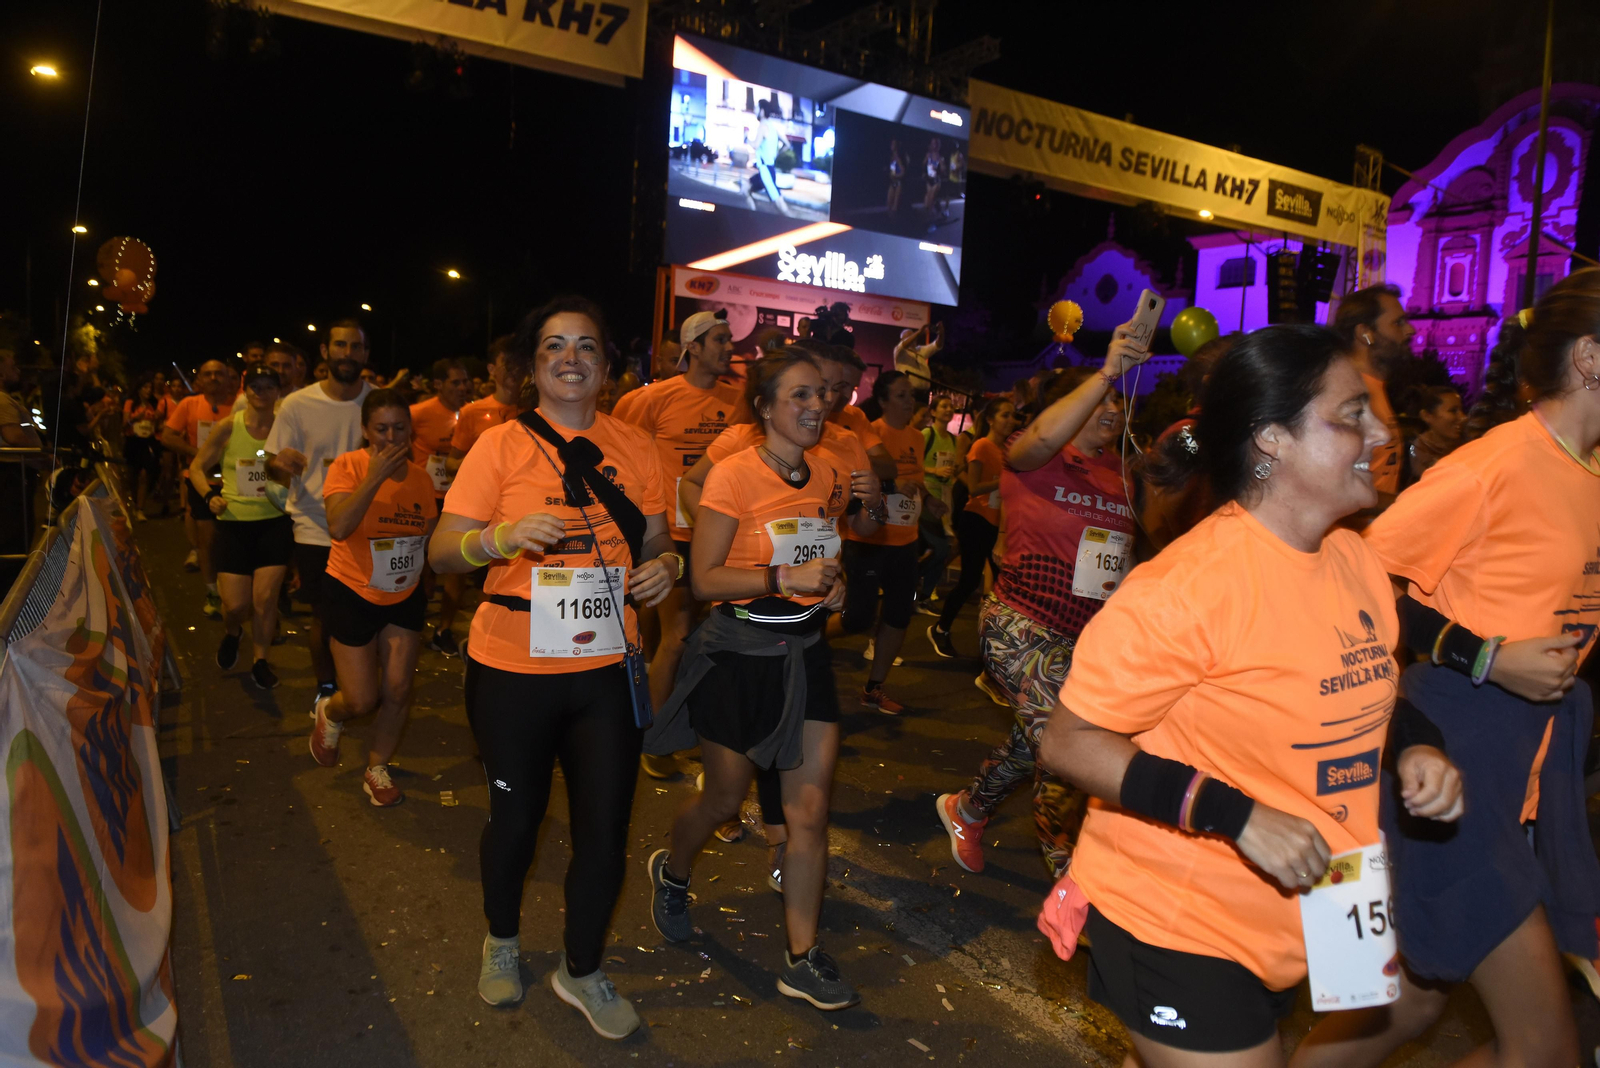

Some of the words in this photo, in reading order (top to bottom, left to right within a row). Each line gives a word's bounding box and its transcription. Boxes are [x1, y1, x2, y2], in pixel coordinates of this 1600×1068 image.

[974, 108, 1113, 167] NOCTURNA
[1118, 146, 1208, 191] SEVILLA
[898, 499, 916, 510] 4575
[1054, 486, 1092, 507] Los
[378, 517, 410, 526] SEVILLA
[1067, 508, 1092, 518] CLUB
[1093, 513, 1104, 521] DE
[390, 555, 414, 570] 6581
[793, 544, 825, 564] 2963
[557, 597, 611, 619] 11689
[1340, 643, 1388, 668] NOCTURN
[1319, 668, 1373, 696] SEVILLA
